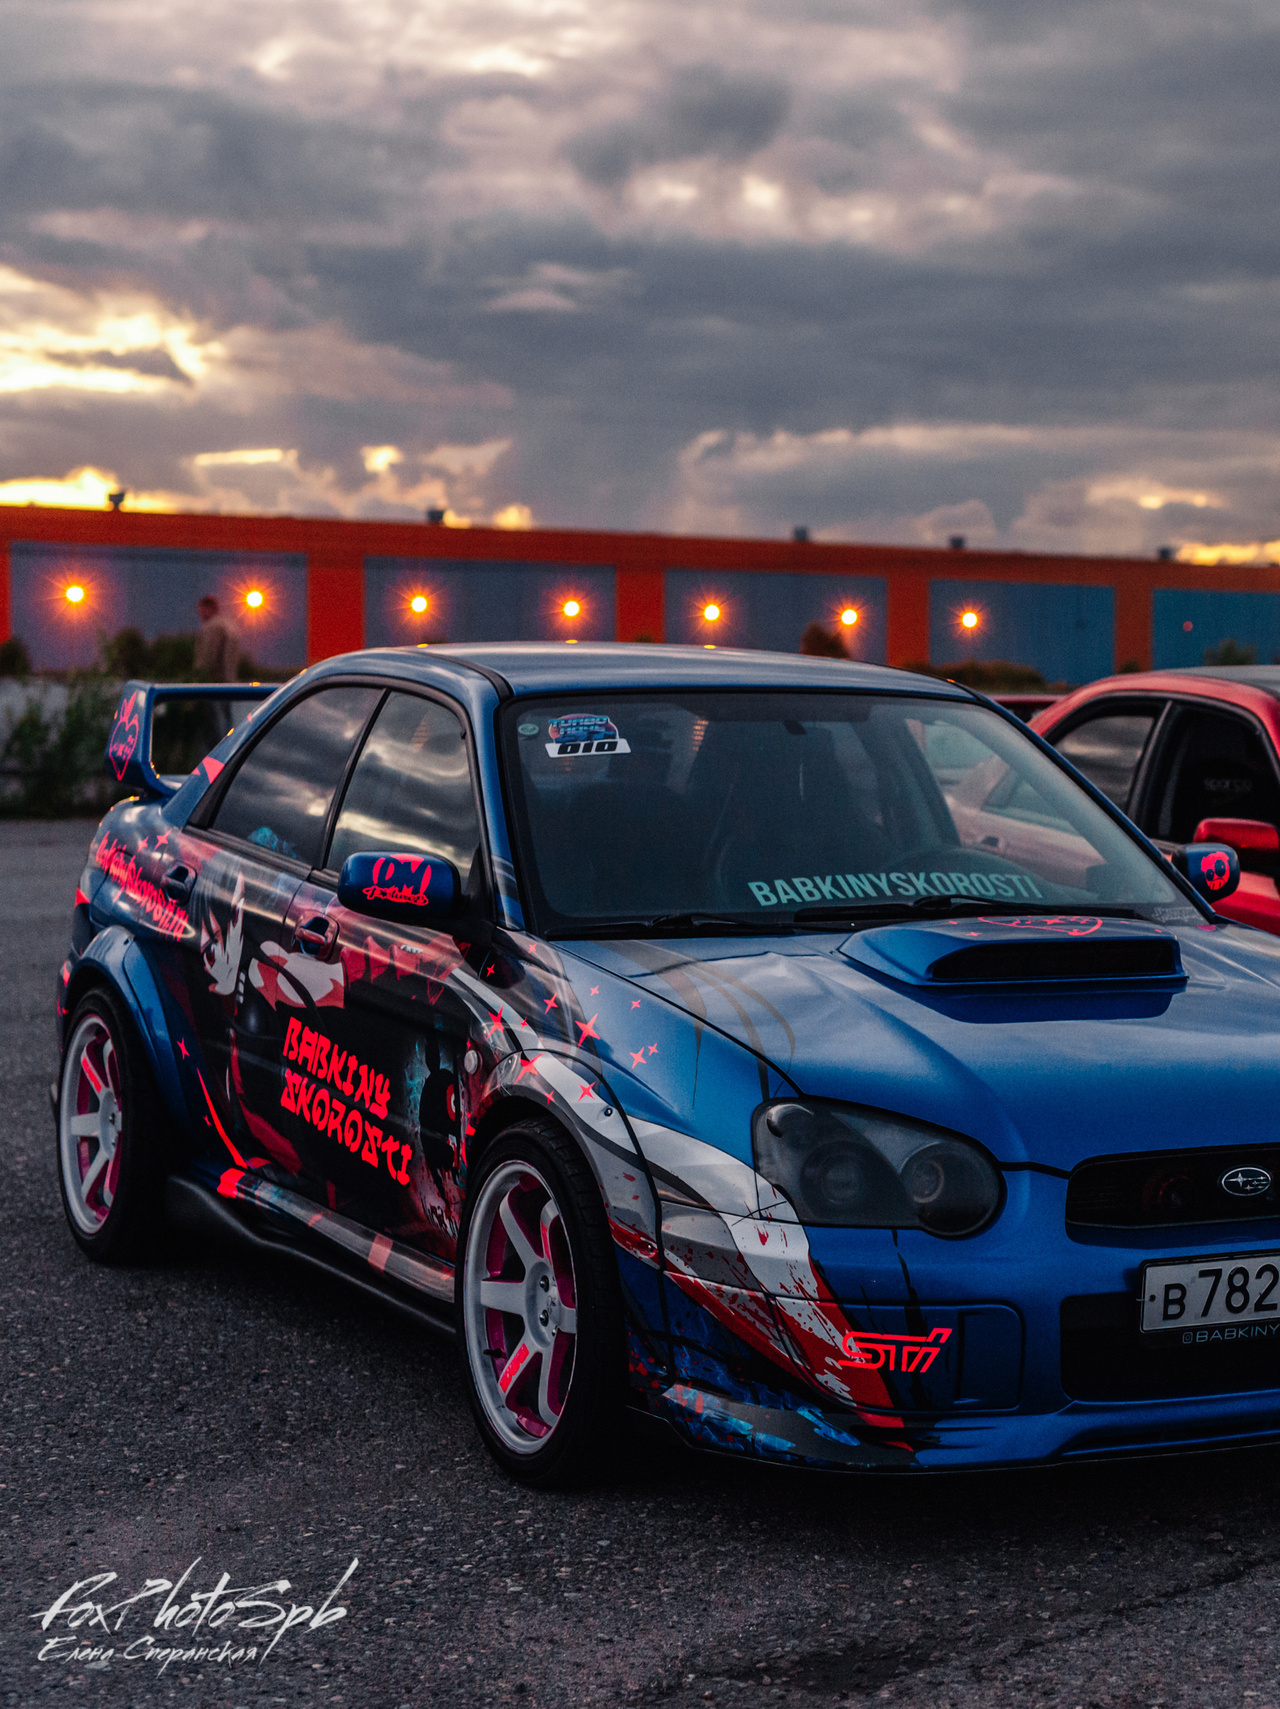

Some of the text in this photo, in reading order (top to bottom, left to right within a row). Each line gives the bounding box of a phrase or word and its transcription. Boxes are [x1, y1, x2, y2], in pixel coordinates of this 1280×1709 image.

[557, 741, 618, 755] 010
[747, 872, 1043, 907] BABKINYSKOROSTI
[283, 1016, 391, 1120] BABKINY
